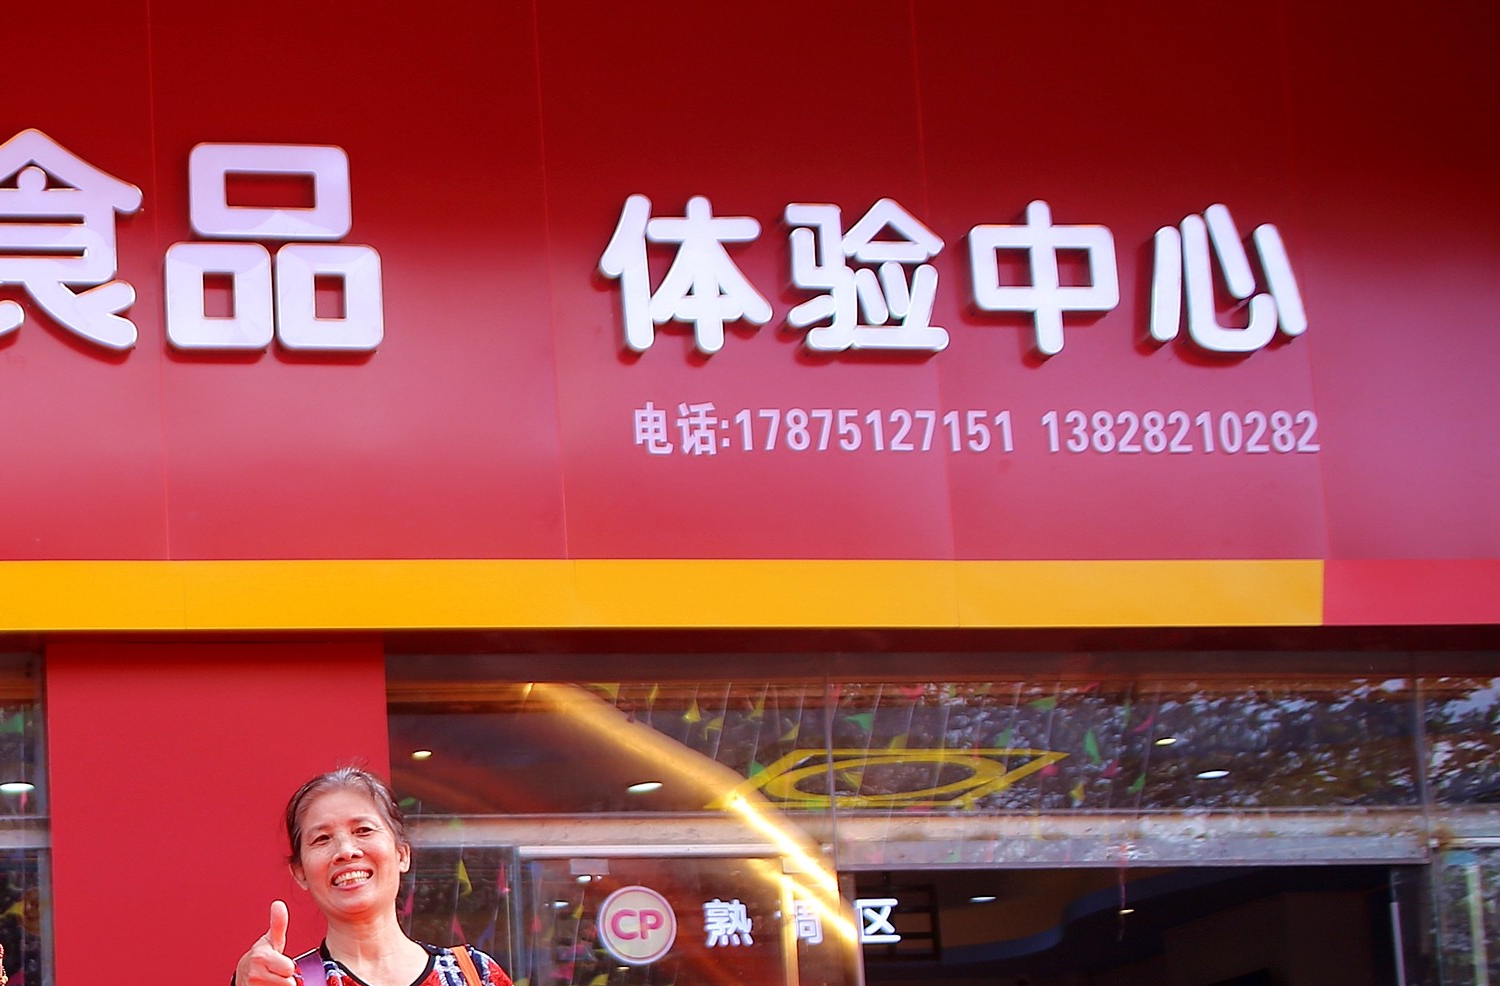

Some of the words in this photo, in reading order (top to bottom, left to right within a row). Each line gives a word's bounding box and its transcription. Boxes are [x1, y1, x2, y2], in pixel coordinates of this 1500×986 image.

[600, 194, 1308, 356] 体验中心
[632, 401, 1015, 456] 电话:17875127151
[1041, 409, 1320, 454] 13828210282
[610, 908, 664, 941] CP
